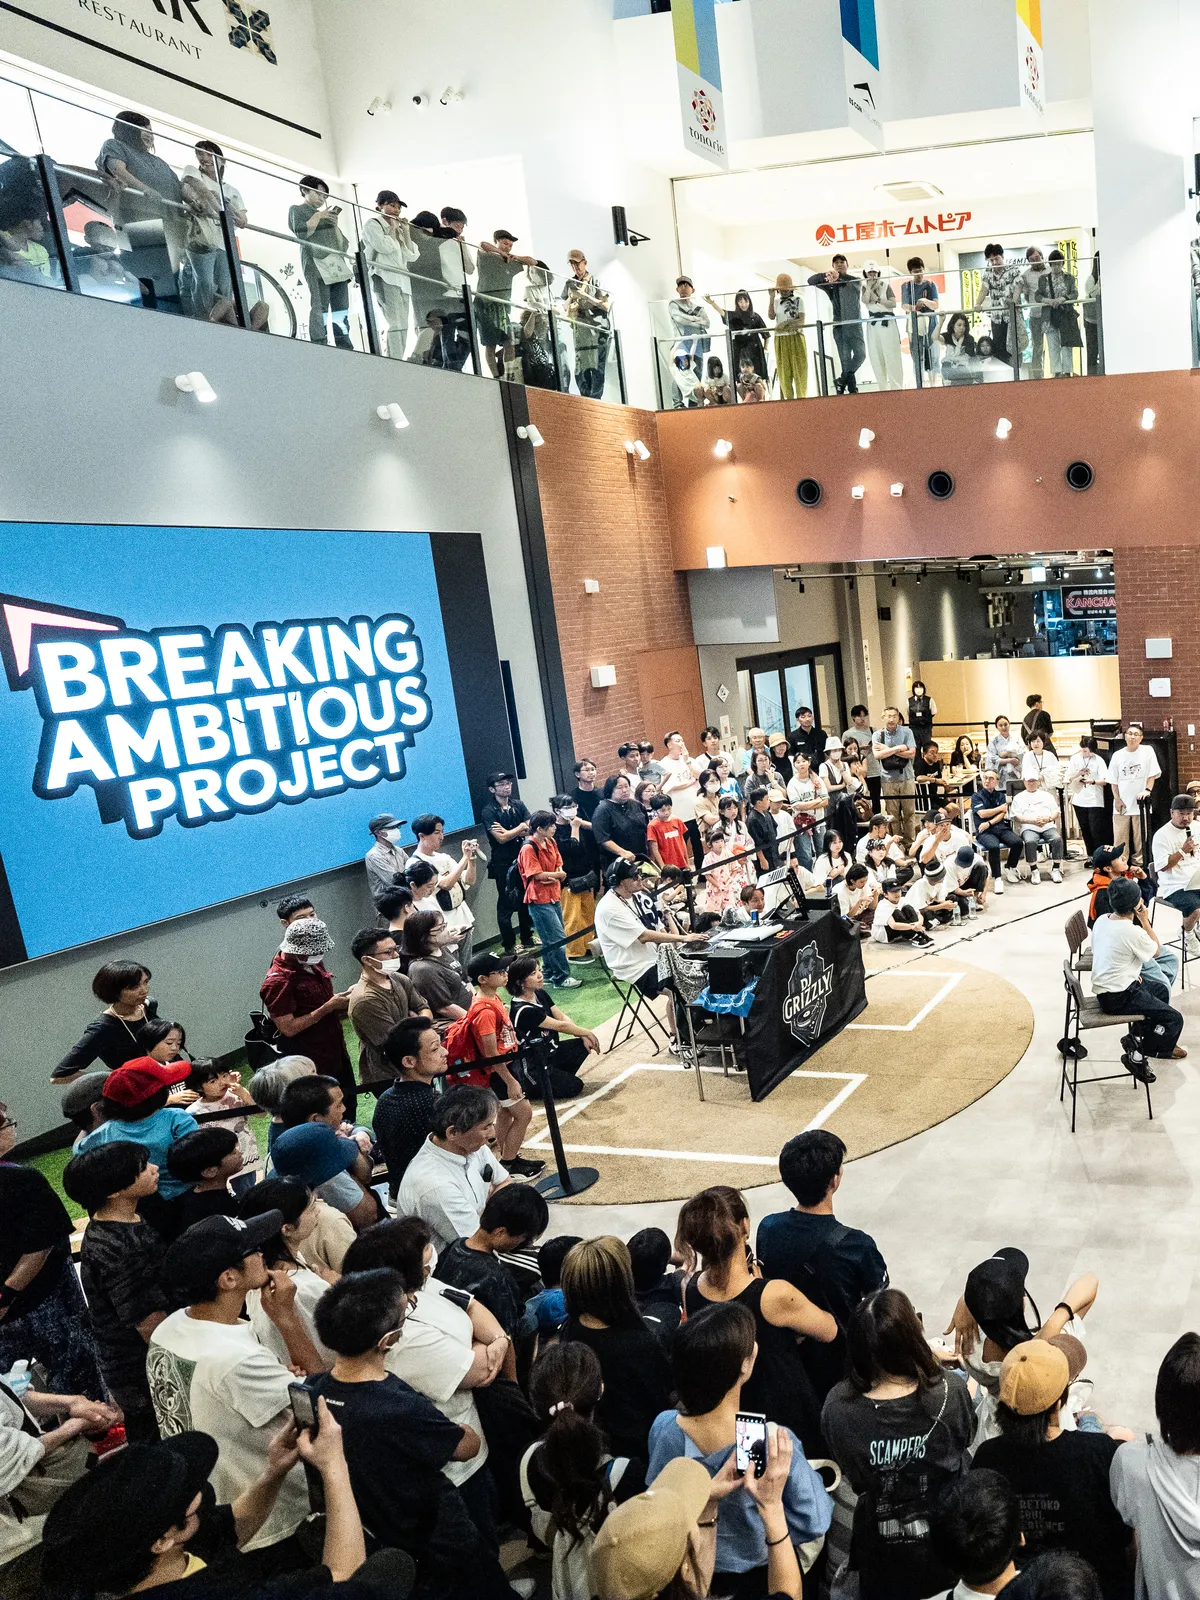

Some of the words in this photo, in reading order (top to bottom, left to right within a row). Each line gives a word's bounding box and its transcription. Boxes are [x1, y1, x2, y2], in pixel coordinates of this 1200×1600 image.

[79, 0, 202, 60] RESTAURANT
[688, 126, 725, 154] tonarie
[836, 211, 972, 243] 土屋ホームトピア
[36, 619, 420, 715] BREAKING
[45, 675, 429, 790] AMBITIOUS
[128, 731, 406, 830] PROJECT
[784, 970, 831, 1020] GRIZZLY
[800, 974, 812, 991] DJ
[869, 1433, 927, 1466] SCAMPERS
